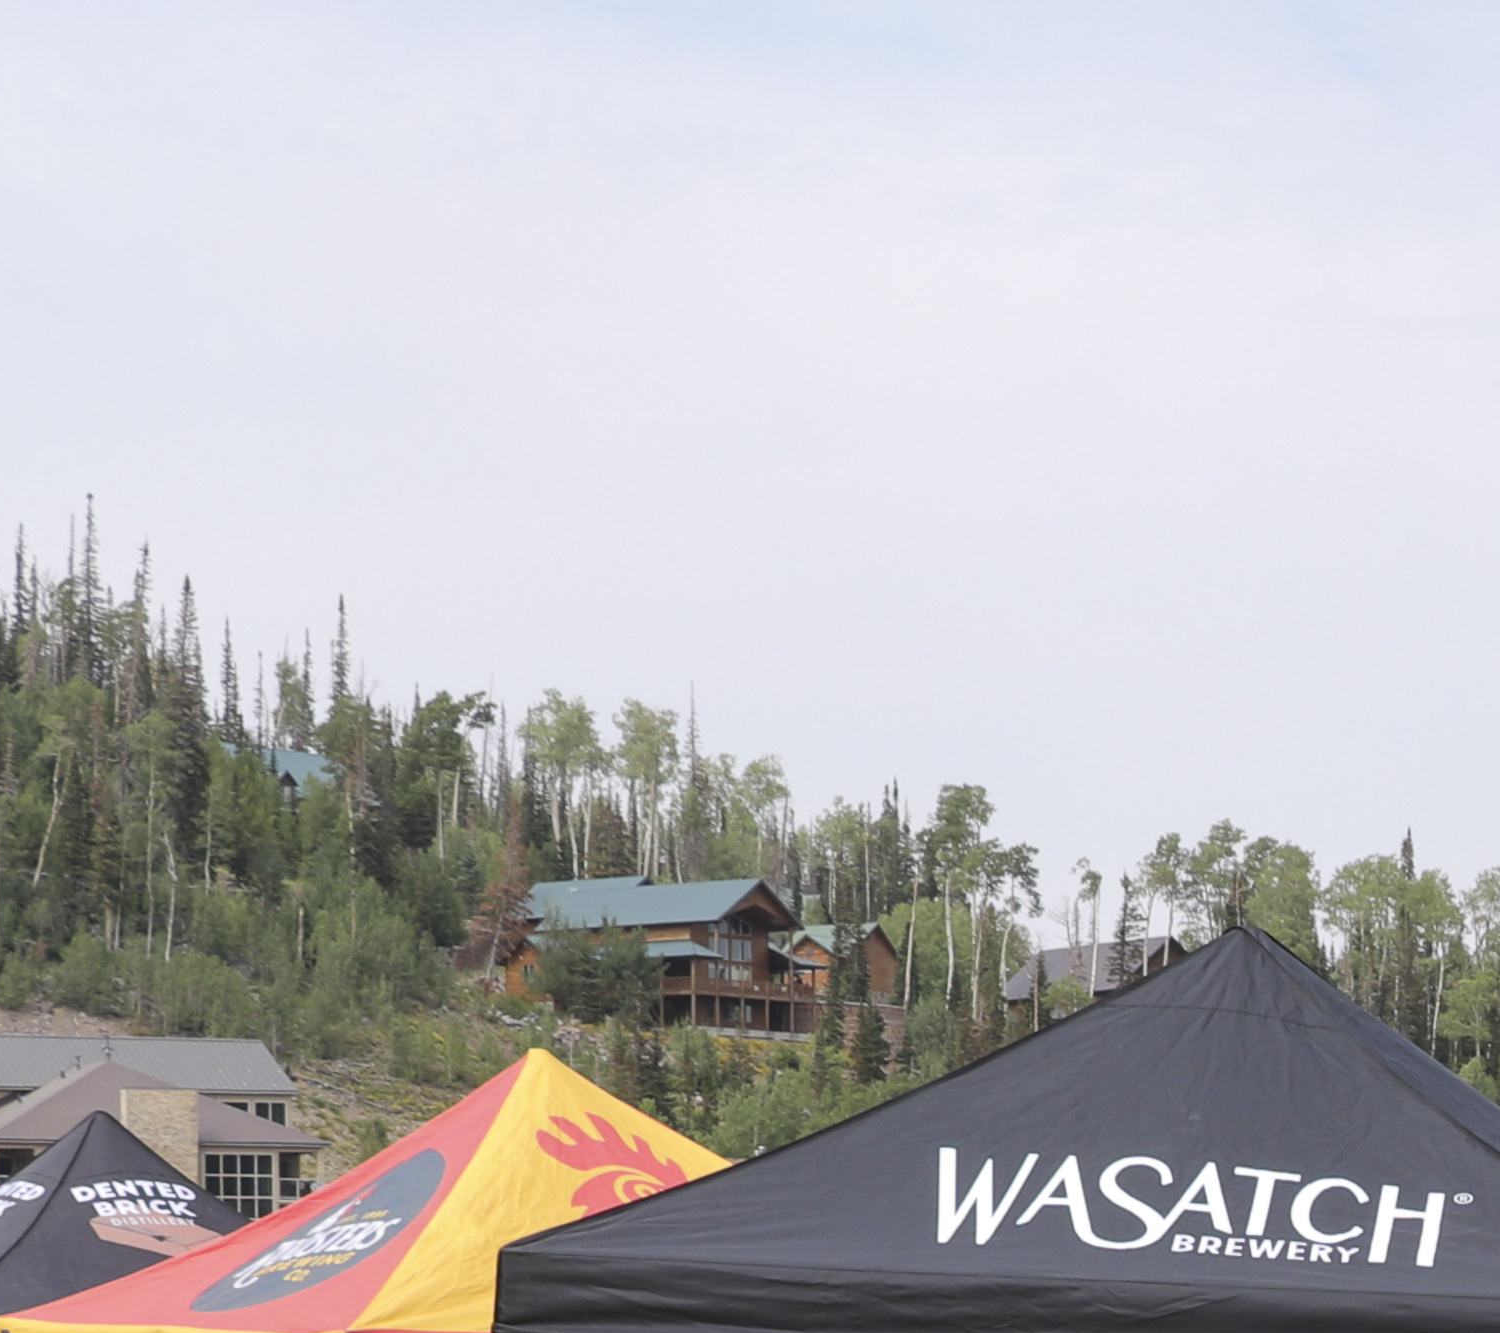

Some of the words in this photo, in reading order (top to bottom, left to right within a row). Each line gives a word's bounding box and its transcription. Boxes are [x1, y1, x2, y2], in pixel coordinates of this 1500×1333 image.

[69, 1180, 197, 1203] DENTED
[92, 1199, 198, 1218] BRICK
[110, 1216, 196, 1228] DISTILLERY
[1170, 1233, 1360, 1265] BREWERY
